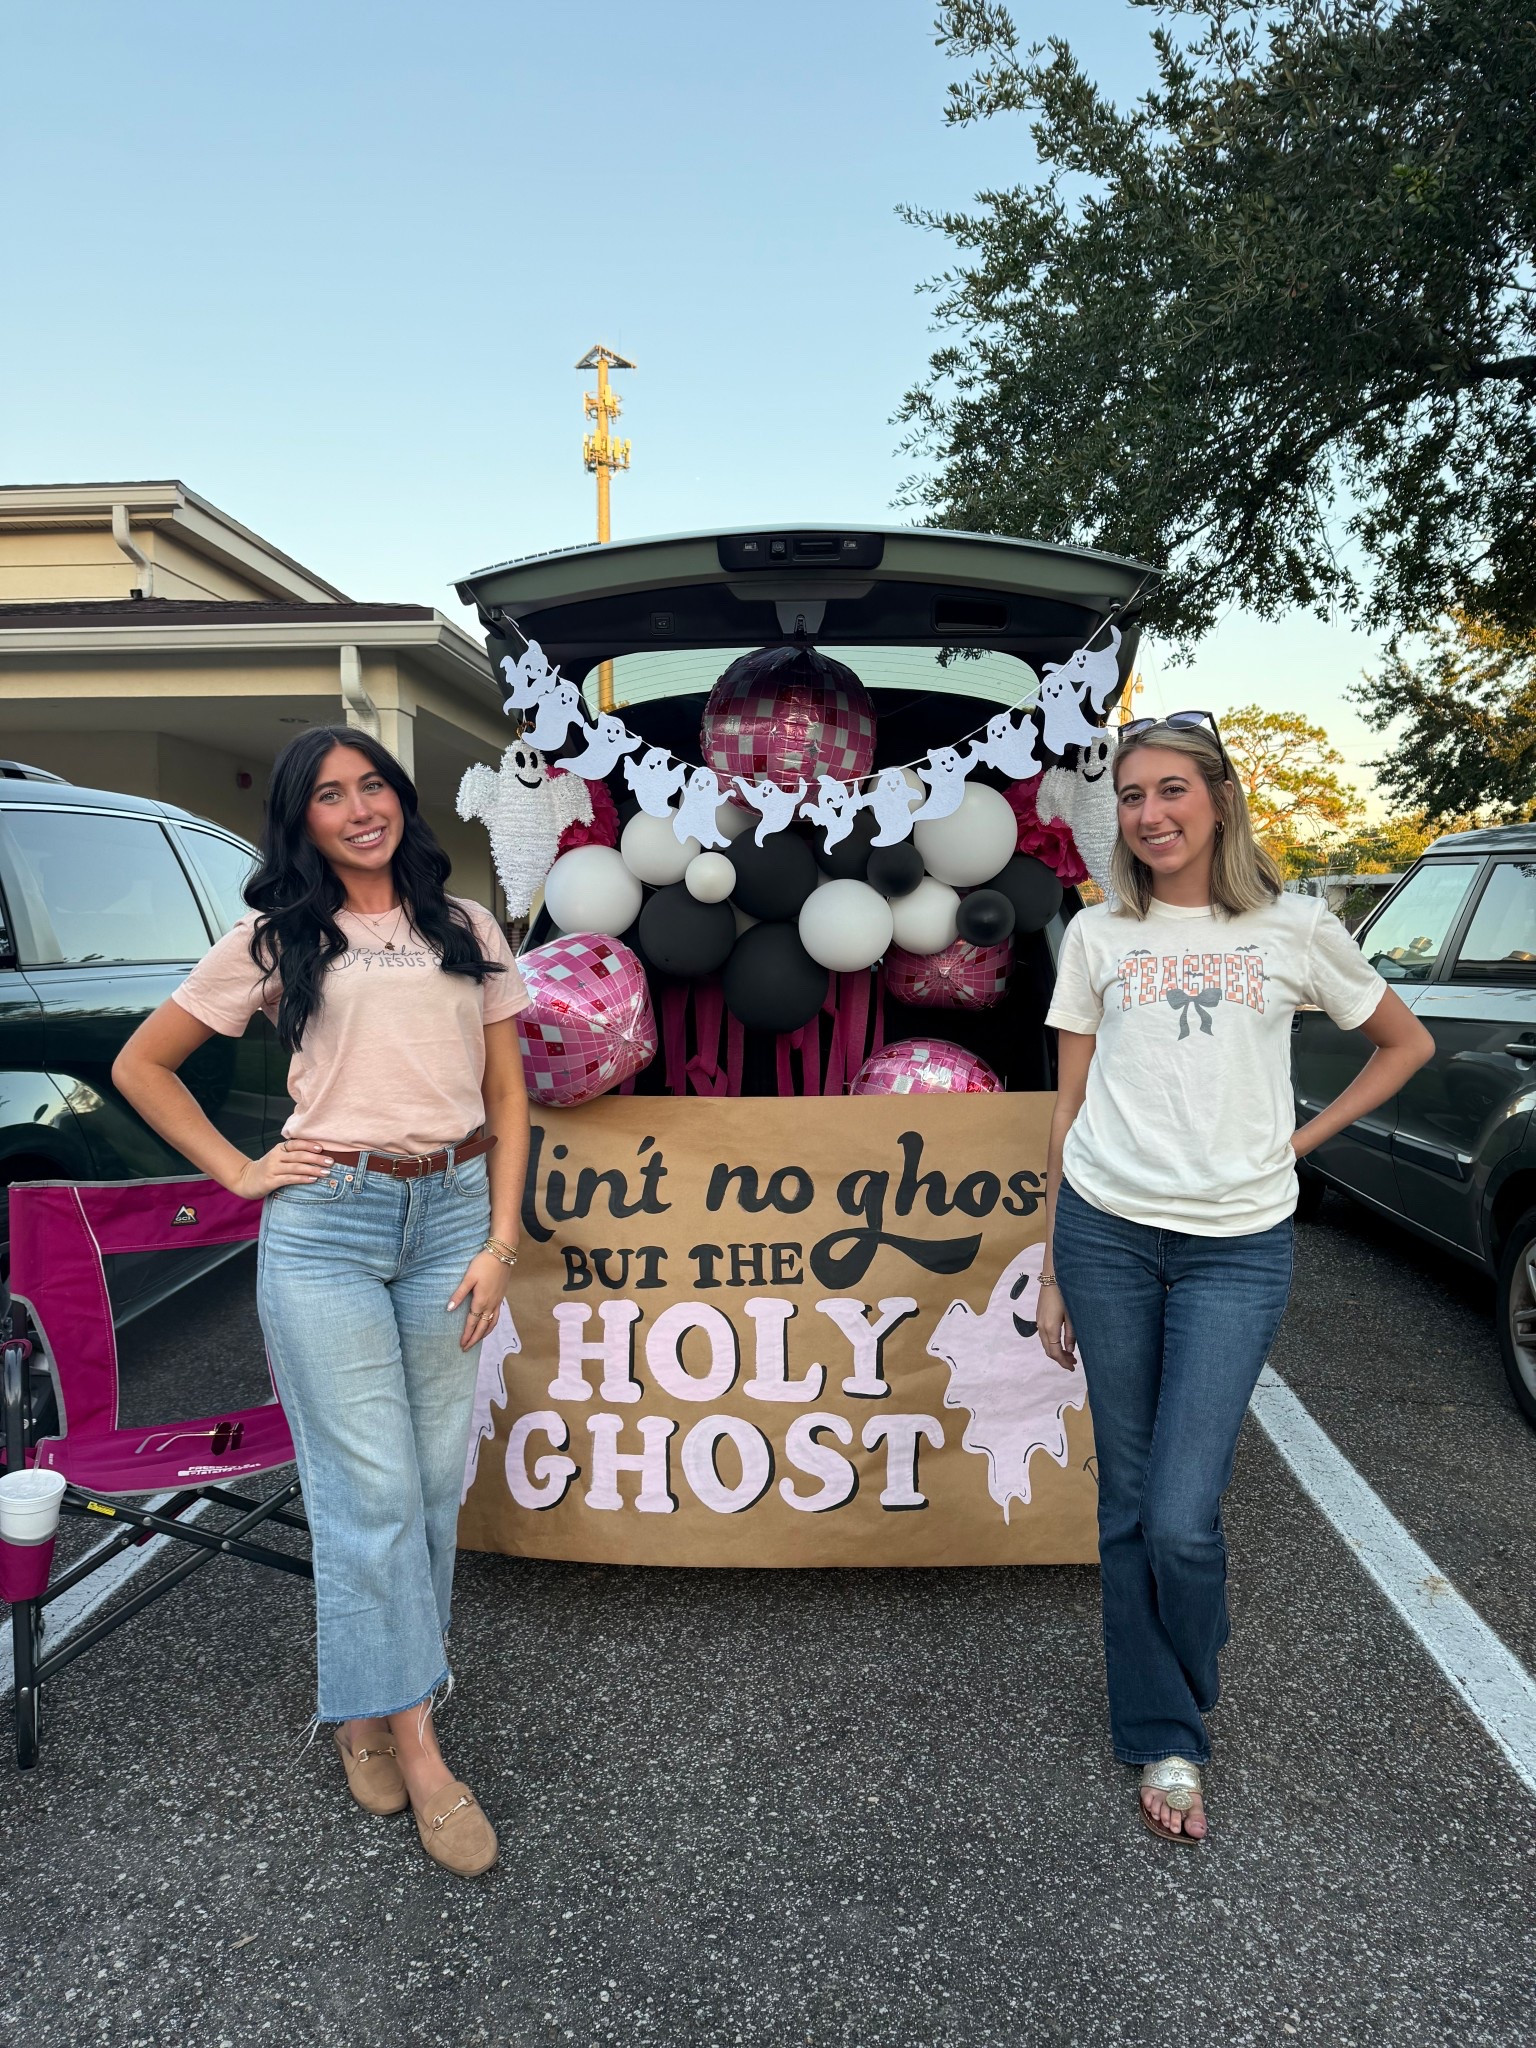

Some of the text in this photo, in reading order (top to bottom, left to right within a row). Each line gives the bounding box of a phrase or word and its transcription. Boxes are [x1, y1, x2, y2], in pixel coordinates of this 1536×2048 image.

[379, 957, 427, 968] JESUS
[1117, 953, 1265, 1015] TEACHER
[706, 1162, 815, 1214] no
[560, 1241, 804, 1291] BUT THE
[547, 1296, 920, 1403] HOLY
[504, 1409, 945, 1515] GHOST
